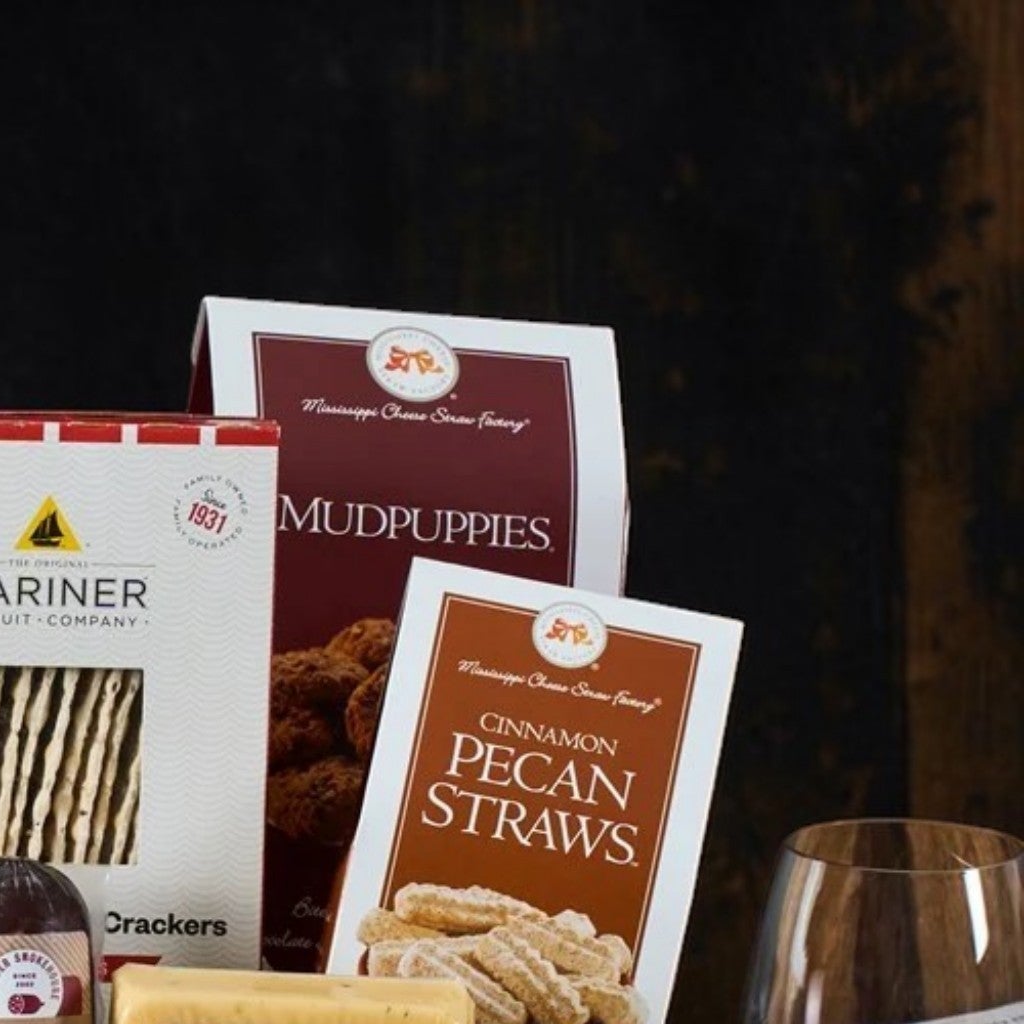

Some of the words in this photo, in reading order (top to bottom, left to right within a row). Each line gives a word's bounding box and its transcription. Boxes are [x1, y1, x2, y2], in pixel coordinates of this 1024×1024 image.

[301, 398, 379, 422] Mississippi
[380, 402, 428, 421] Cheese
[476, 411, 525, 434] Factory
[188, 502, 227, 534] 1931
[277, 495, 551, 551] MUDPUPPIES
[9, 559, 29, 568] THE
[34, 559, 89, 569] ORIGINAL
[46, 614, 138, 628] COMPANY
[458, 659, 526, 687] Mississippi
[527, 671, 570, 693] Cheese
[479, 712, 618, 757] CINNAMON
[445, 731, 637, 811] PECAN
[421, 782, 639, 866] STRAWS
[105, 911, 228, 937] Crackers
[12, 972, 37, 980] SINCE
[14, 951, 60, 1000] SMOKEHOUSE
